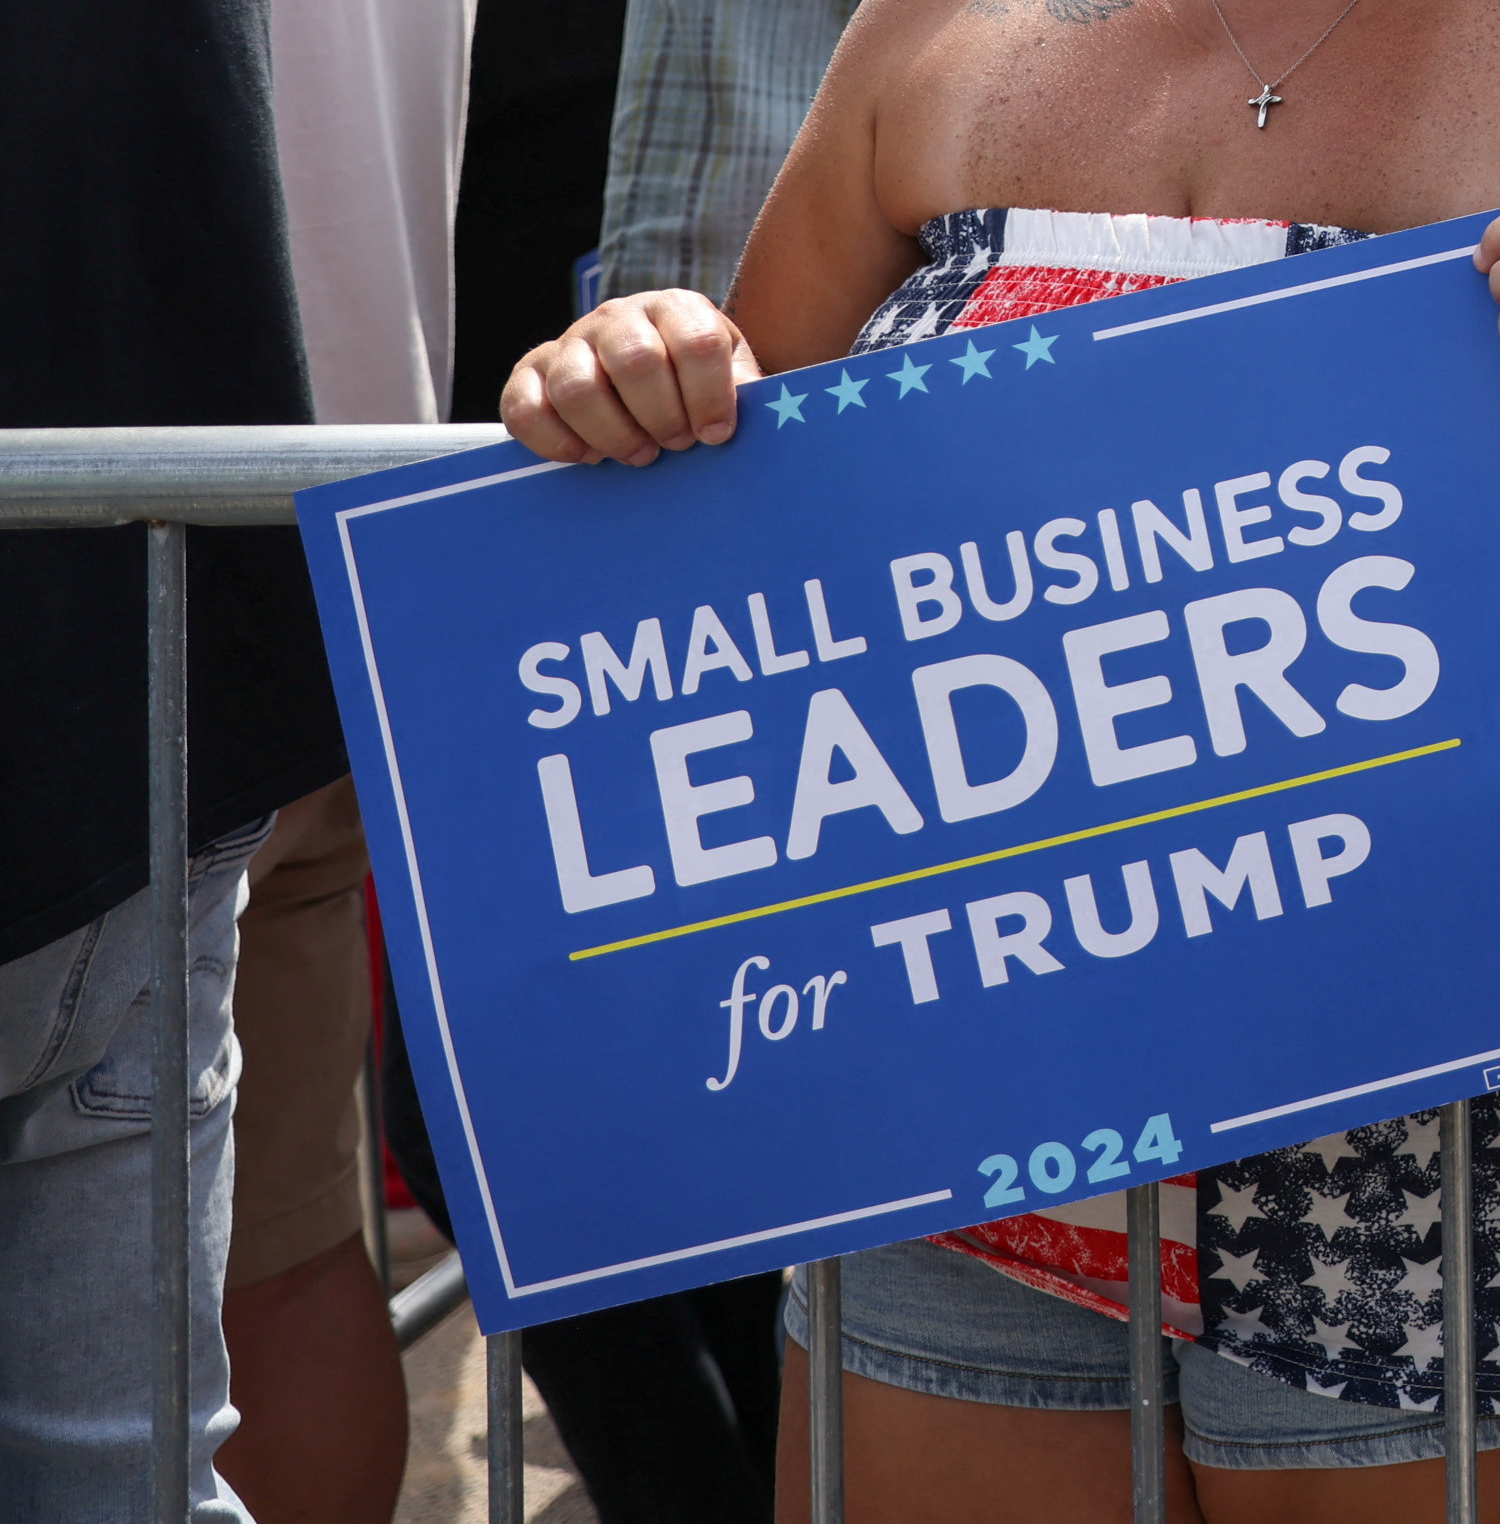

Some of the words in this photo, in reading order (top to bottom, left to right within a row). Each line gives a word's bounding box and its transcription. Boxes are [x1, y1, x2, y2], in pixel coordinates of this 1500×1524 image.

[519, 579, 868, 728] SMALL
[890, 446, 1402, 641] BUSINESS
[538, 555, 1440, 914] LEADERS
[706, 956, 848, 1090] for
[871, 814, 1372, 1005] TRUMP
[977, 1112, 1184, 1209] 2024
